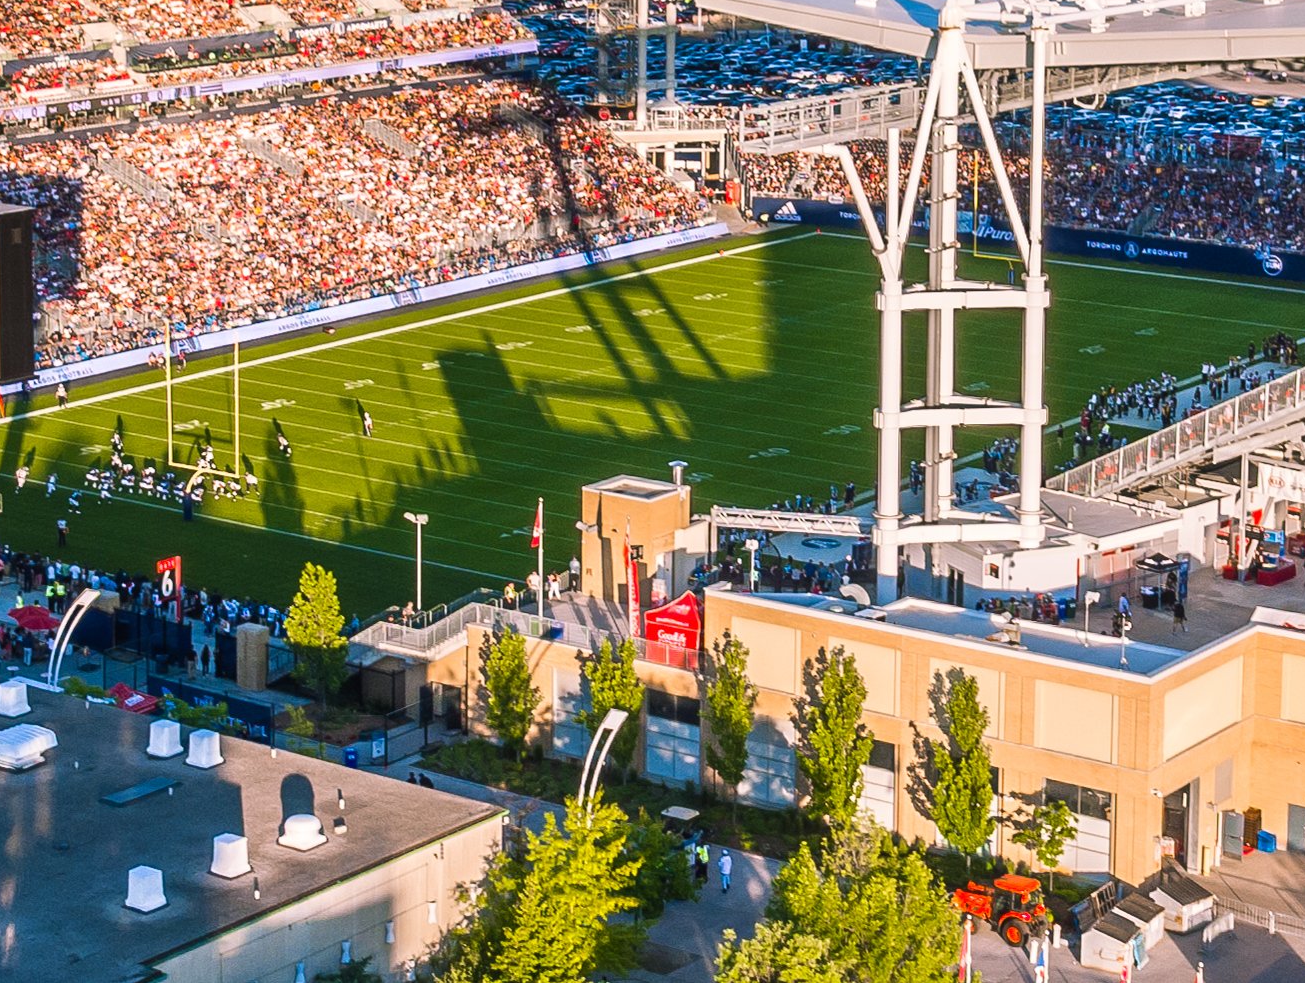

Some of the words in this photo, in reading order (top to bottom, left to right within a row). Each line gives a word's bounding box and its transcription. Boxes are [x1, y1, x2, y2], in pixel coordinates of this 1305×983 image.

[1086, 240, 1121, 252] TORONTO
[1141, 247, 1188, 259] ARGONAUTS
[161, 569, 174, 597] 6
